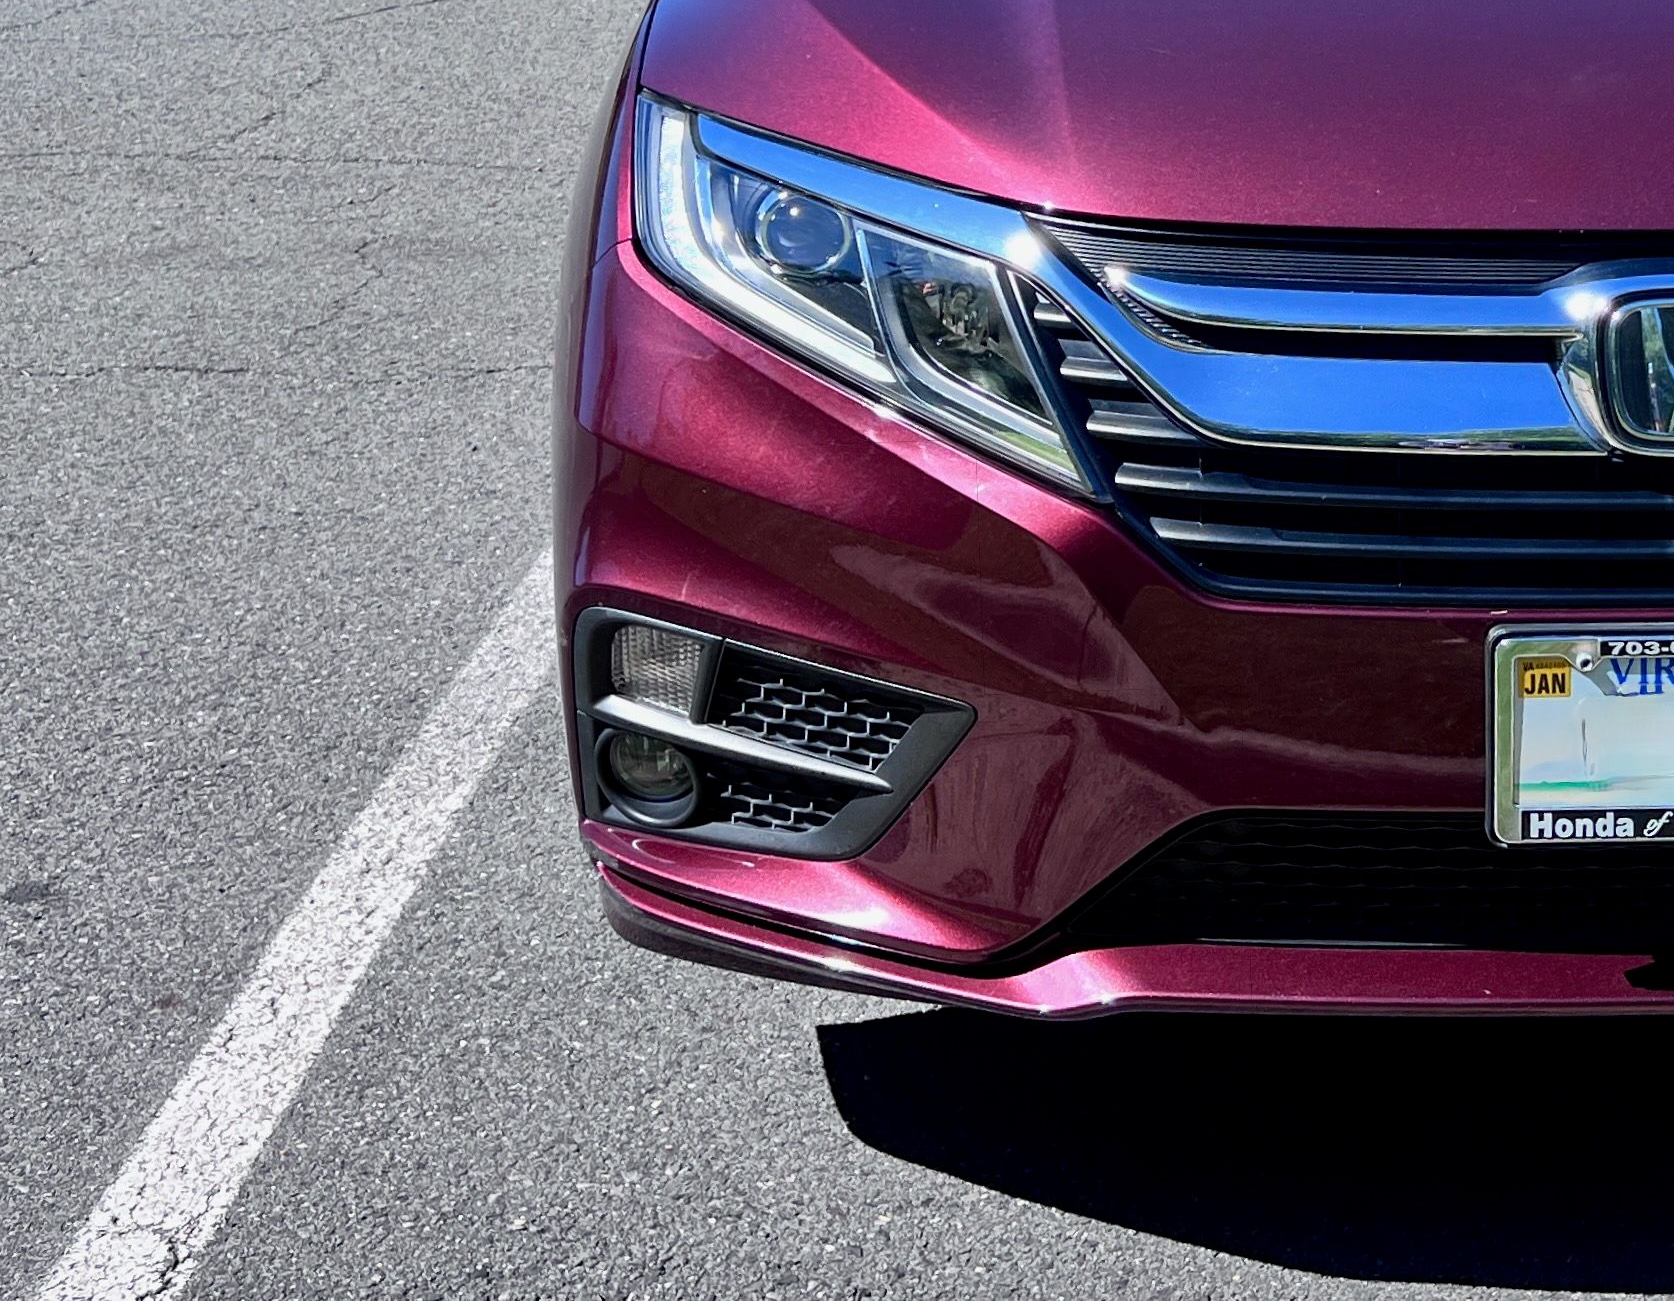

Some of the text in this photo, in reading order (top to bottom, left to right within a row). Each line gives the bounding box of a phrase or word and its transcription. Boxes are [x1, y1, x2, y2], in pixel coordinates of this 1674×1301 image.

[1524, 672, 1566, 695] JAN
[1529, 811, 1635, 839] Honda
[1643, 811, 1674, 837] of
